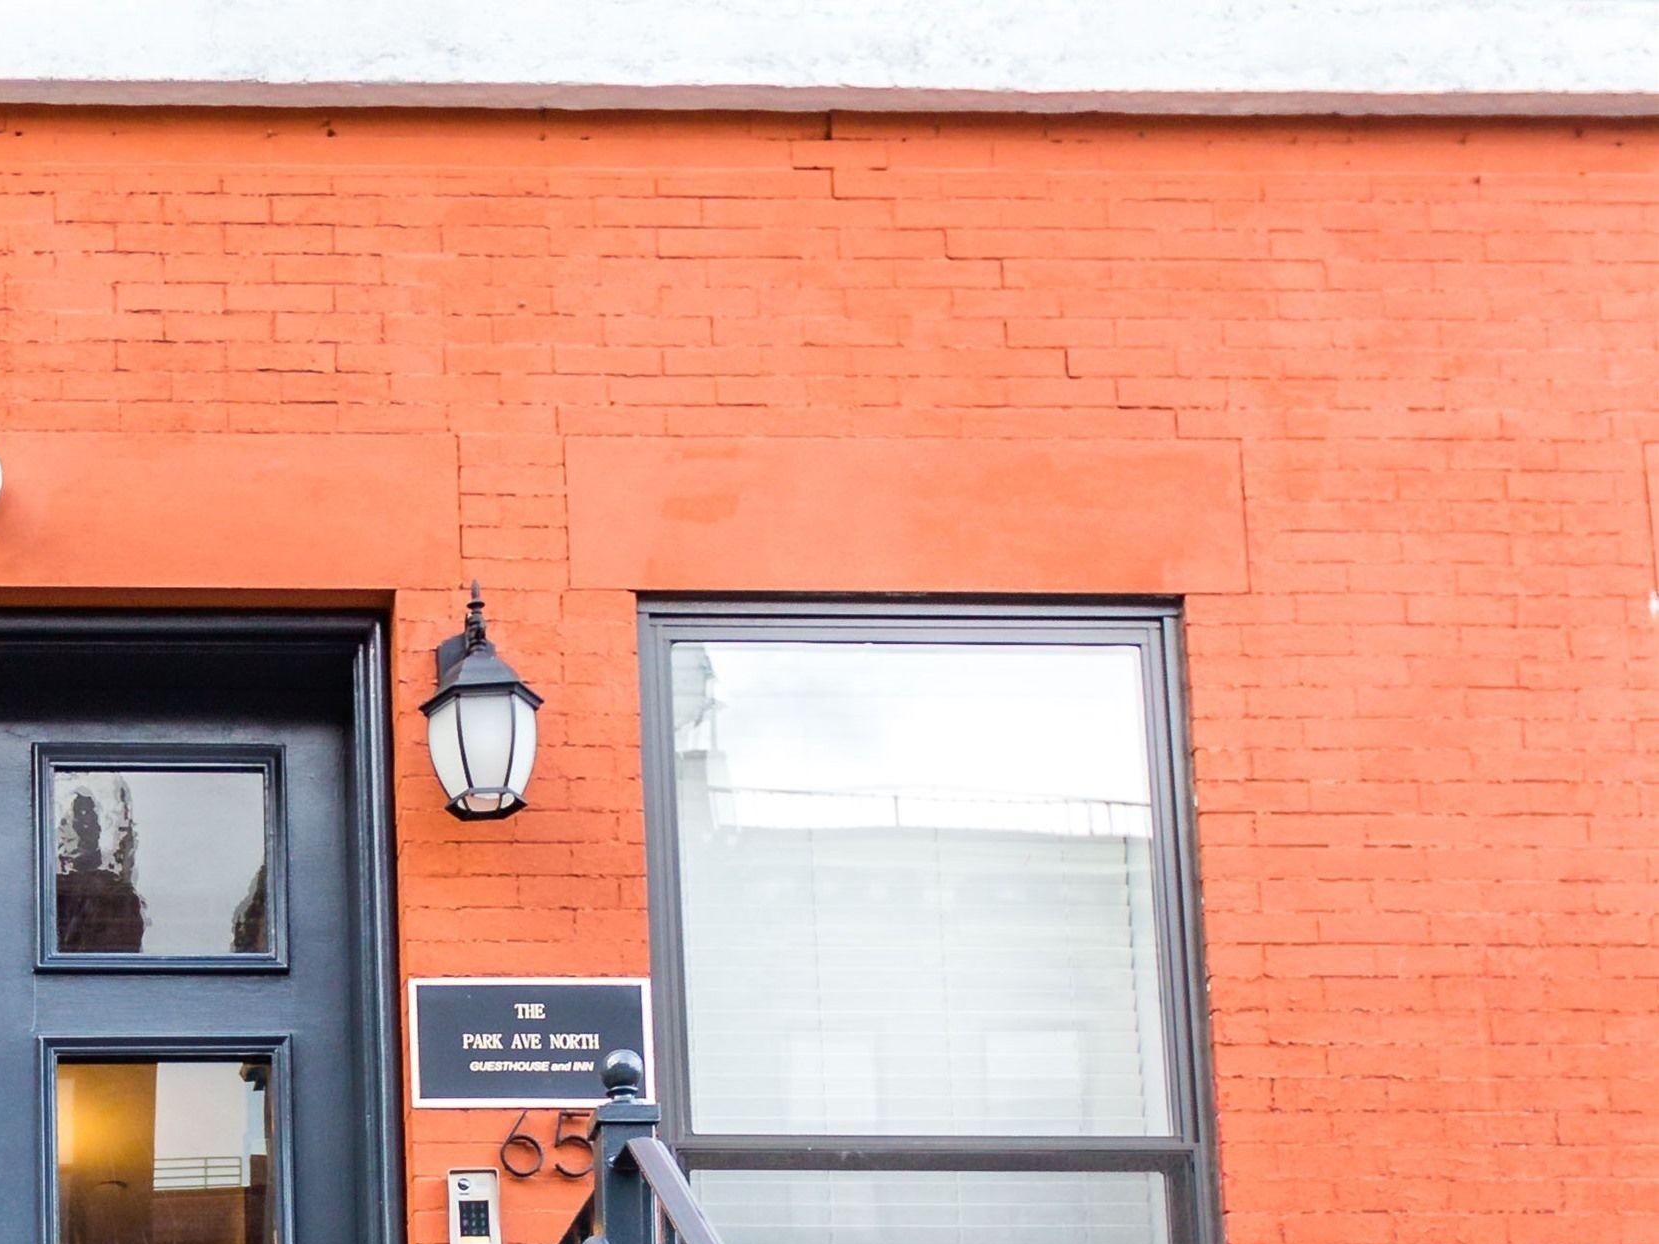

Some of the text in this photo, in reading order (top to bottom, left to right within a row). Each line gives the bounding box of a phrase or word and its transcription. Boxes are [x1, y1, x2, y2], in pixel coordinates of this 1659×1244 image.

[514, 1003, 546, 1019] THE
[462, 1033, 600, 1050] PARK AVE NORTH
[469, 1061, 594, 1072] GUESTHOUSE and INN
[500, 1109, 593, 1178] 65
